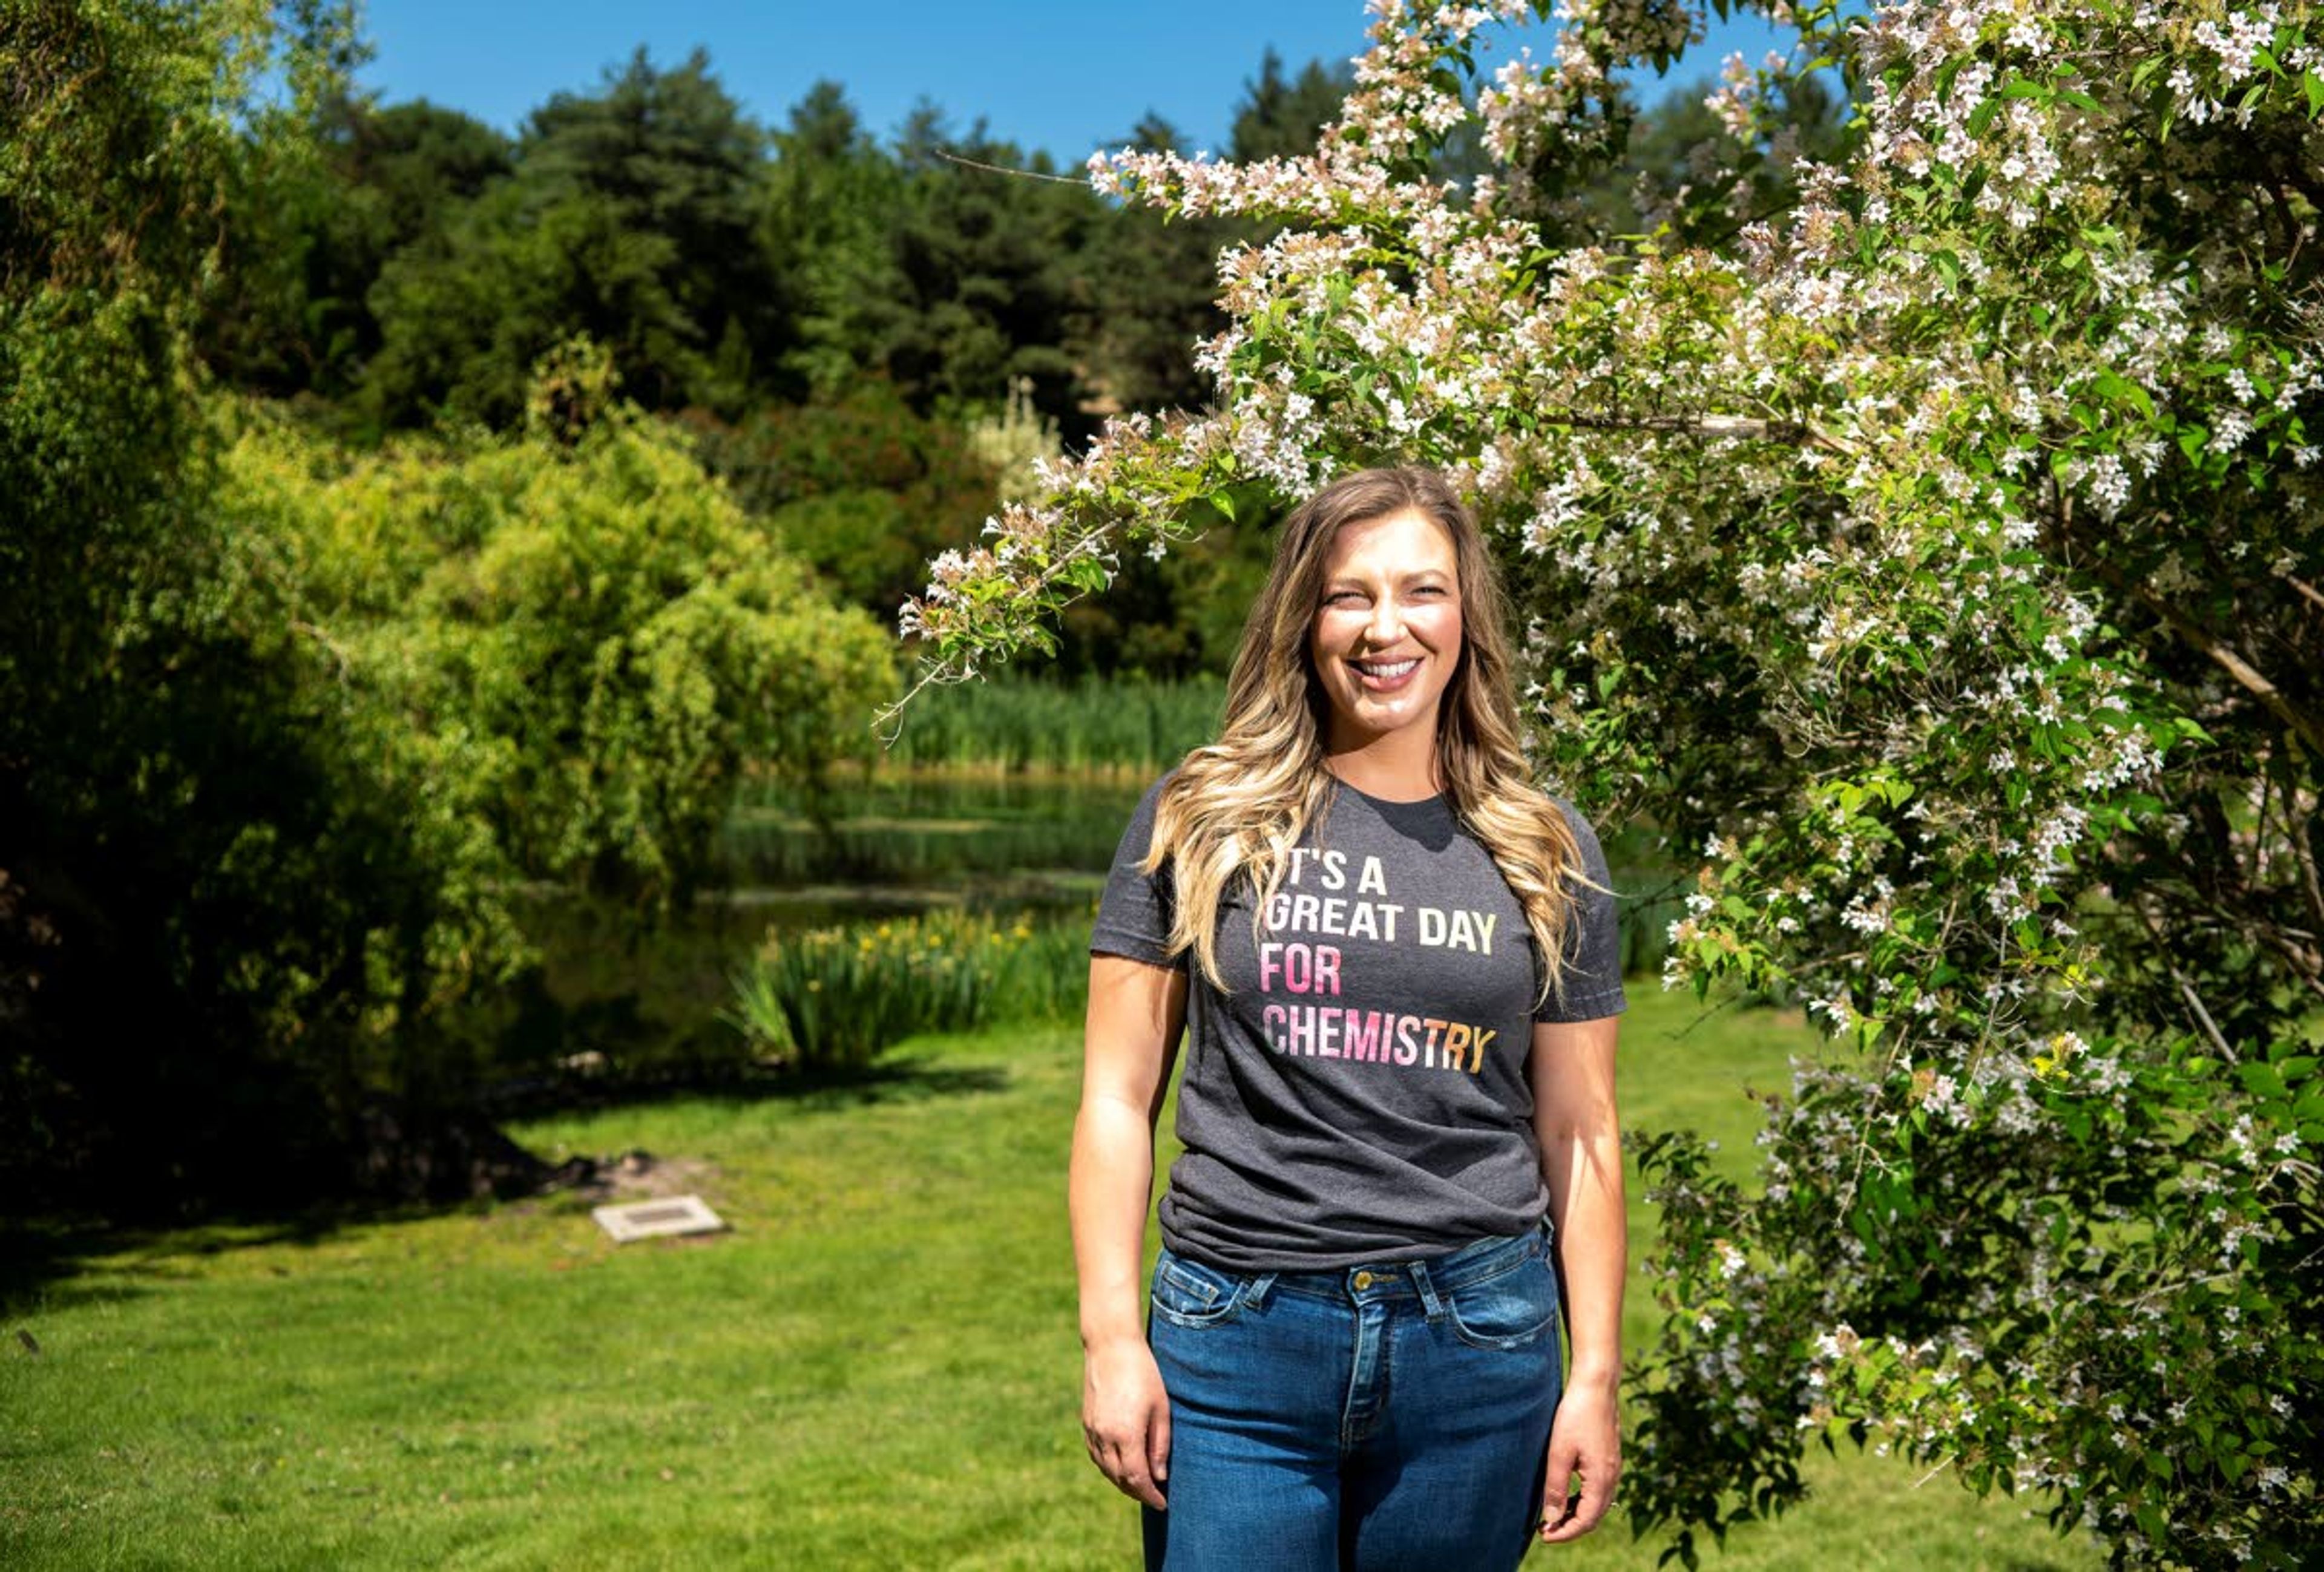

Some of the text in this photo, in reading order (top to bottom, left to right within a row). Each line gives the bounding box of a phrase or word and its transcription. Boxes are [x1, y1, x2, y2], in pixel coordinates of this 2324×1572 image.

[1288, 848, 1387, 896] T'S A
[1263, 892, 1497, 955] GREAT DAY
[1260, 943, 1342, 995] FOR
[1262, 1004, 1496, 1074] CHEMISTRY
